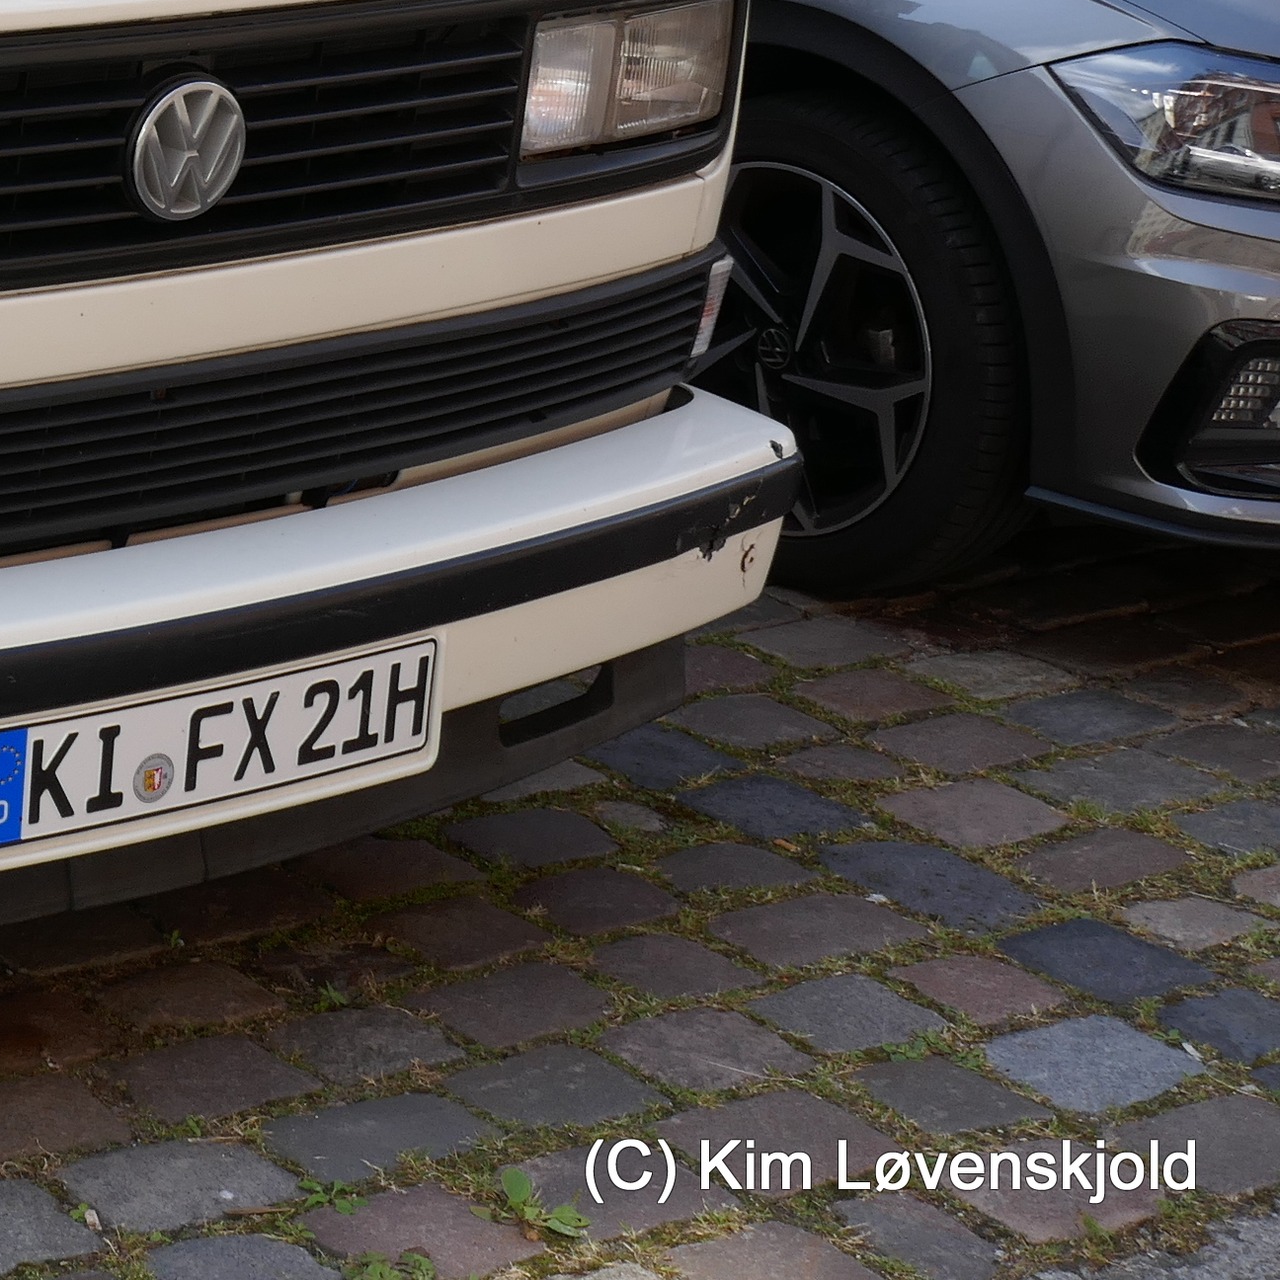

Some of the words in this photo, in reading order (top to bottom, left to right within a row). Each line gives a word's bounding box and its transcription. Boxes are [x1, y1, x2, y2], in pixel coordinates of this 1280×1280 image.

[27, 723, 124, 825] KI
[184, 690, 281, 793] FX
[296, 655, 430, 767] 21H
